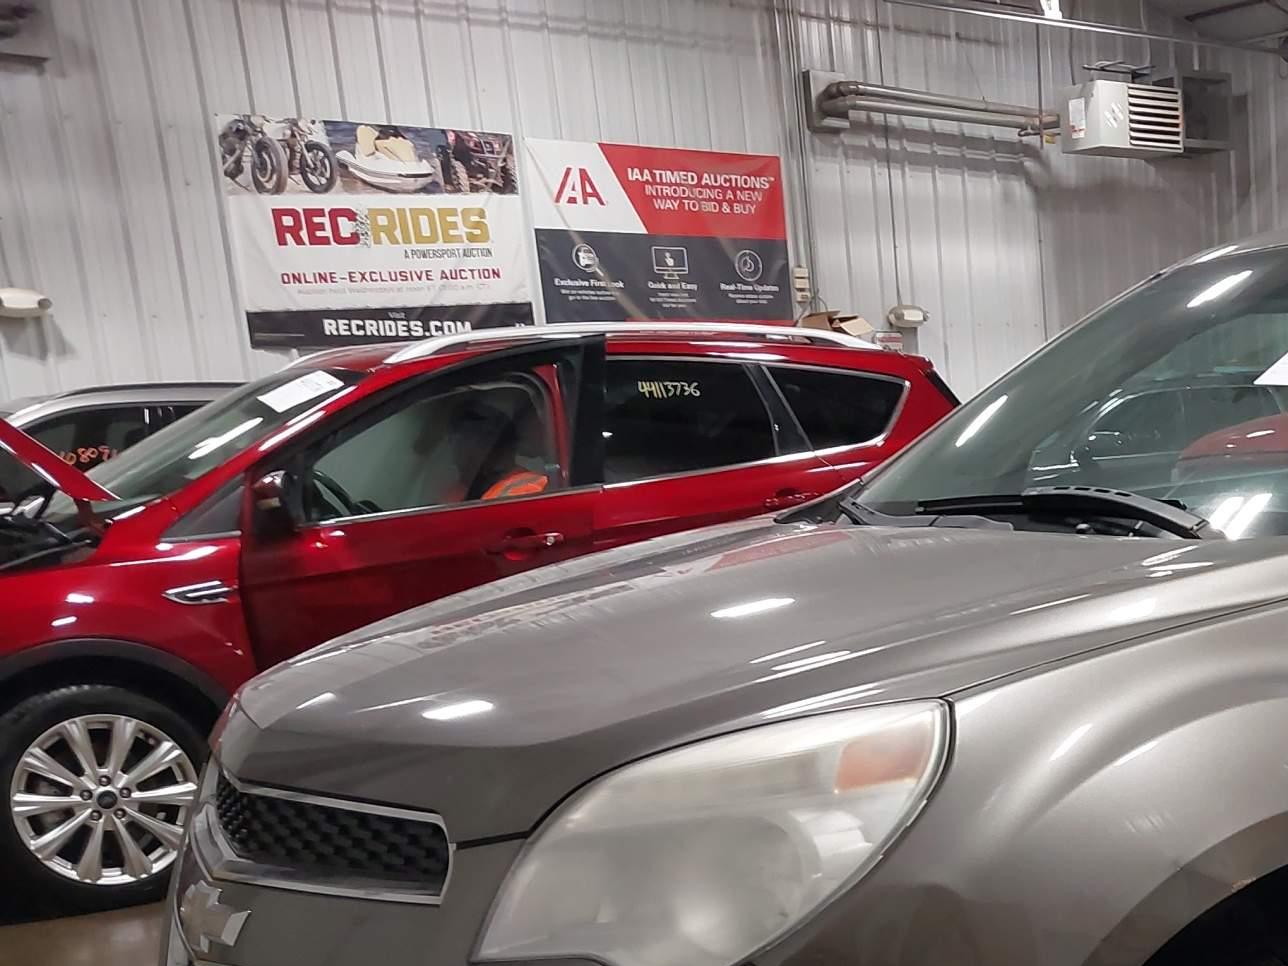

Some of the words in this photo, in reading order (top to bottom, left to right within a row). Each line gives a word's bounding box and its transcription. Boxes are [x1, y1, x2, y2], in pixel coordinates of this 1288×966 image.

[627, 167, 653, 182] IAA
[653, 170, 698, 185] TIMED
[645, 184, 723, 201] INTRODUCING
[725, 187, 735, 200] A
[736, 189, 763, 202] NEW
[653, 197, 681, 211] WAY
[682, 199, 700, 212] TO
[700, 200, 720, 214] BID
[721, 203, 731, 214] &
[733, 203, 757, 215] BUY
[366, 207, 491, 246] RIDES
[404, 249, 410, 260] A
[411, 248, 462, 259] POWERSPORT
[463, 247, 493, 258] AUCTION
[281, 269, 434, 285] ONLINE-EXCLUSIVE
[439, 266, 502, 282] AUCTION
[323, 318, 473, 338] RECRIDES.COM
[637, 380, 702, 399] 44113736
